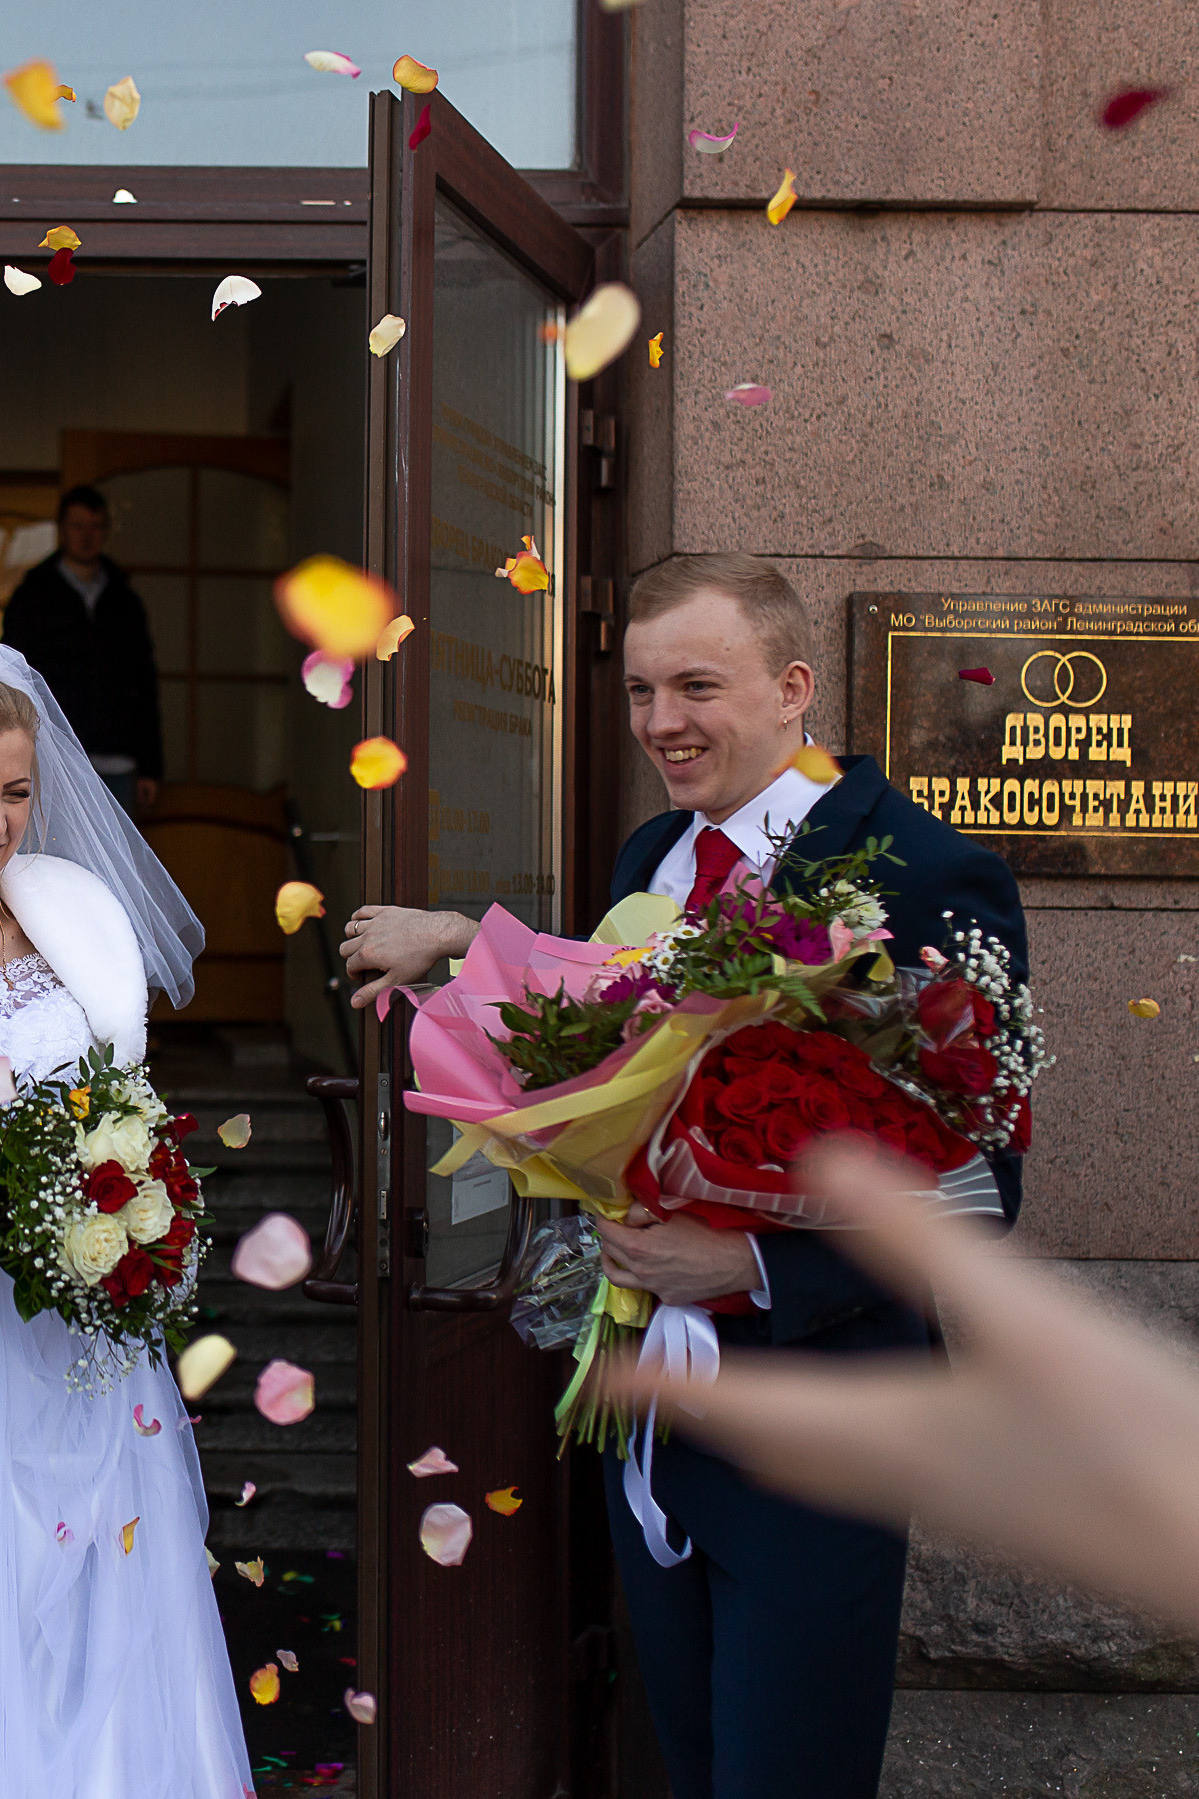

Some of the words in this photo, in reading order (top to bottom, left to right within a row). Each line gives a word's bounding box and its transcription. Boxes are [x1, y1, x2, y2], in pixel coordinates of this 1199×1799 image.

[890, 613, 916, 627] МО
[920, 614, 1010, 630] "Выборгский
[1014, 617, 1063, 632] район"
[1066, 618, 1176, 634] Ленинградской
[941, 597, 1028, 613] Управление
[1032, 599, 1070, 613] ЗАГС
[1074, 602, 1188, 617] администрации
[1002, 712, 1133, 767] ДВОРЕЦ
[909, 776, 1199, 829] БРАКОСОЧЕТАНИ
